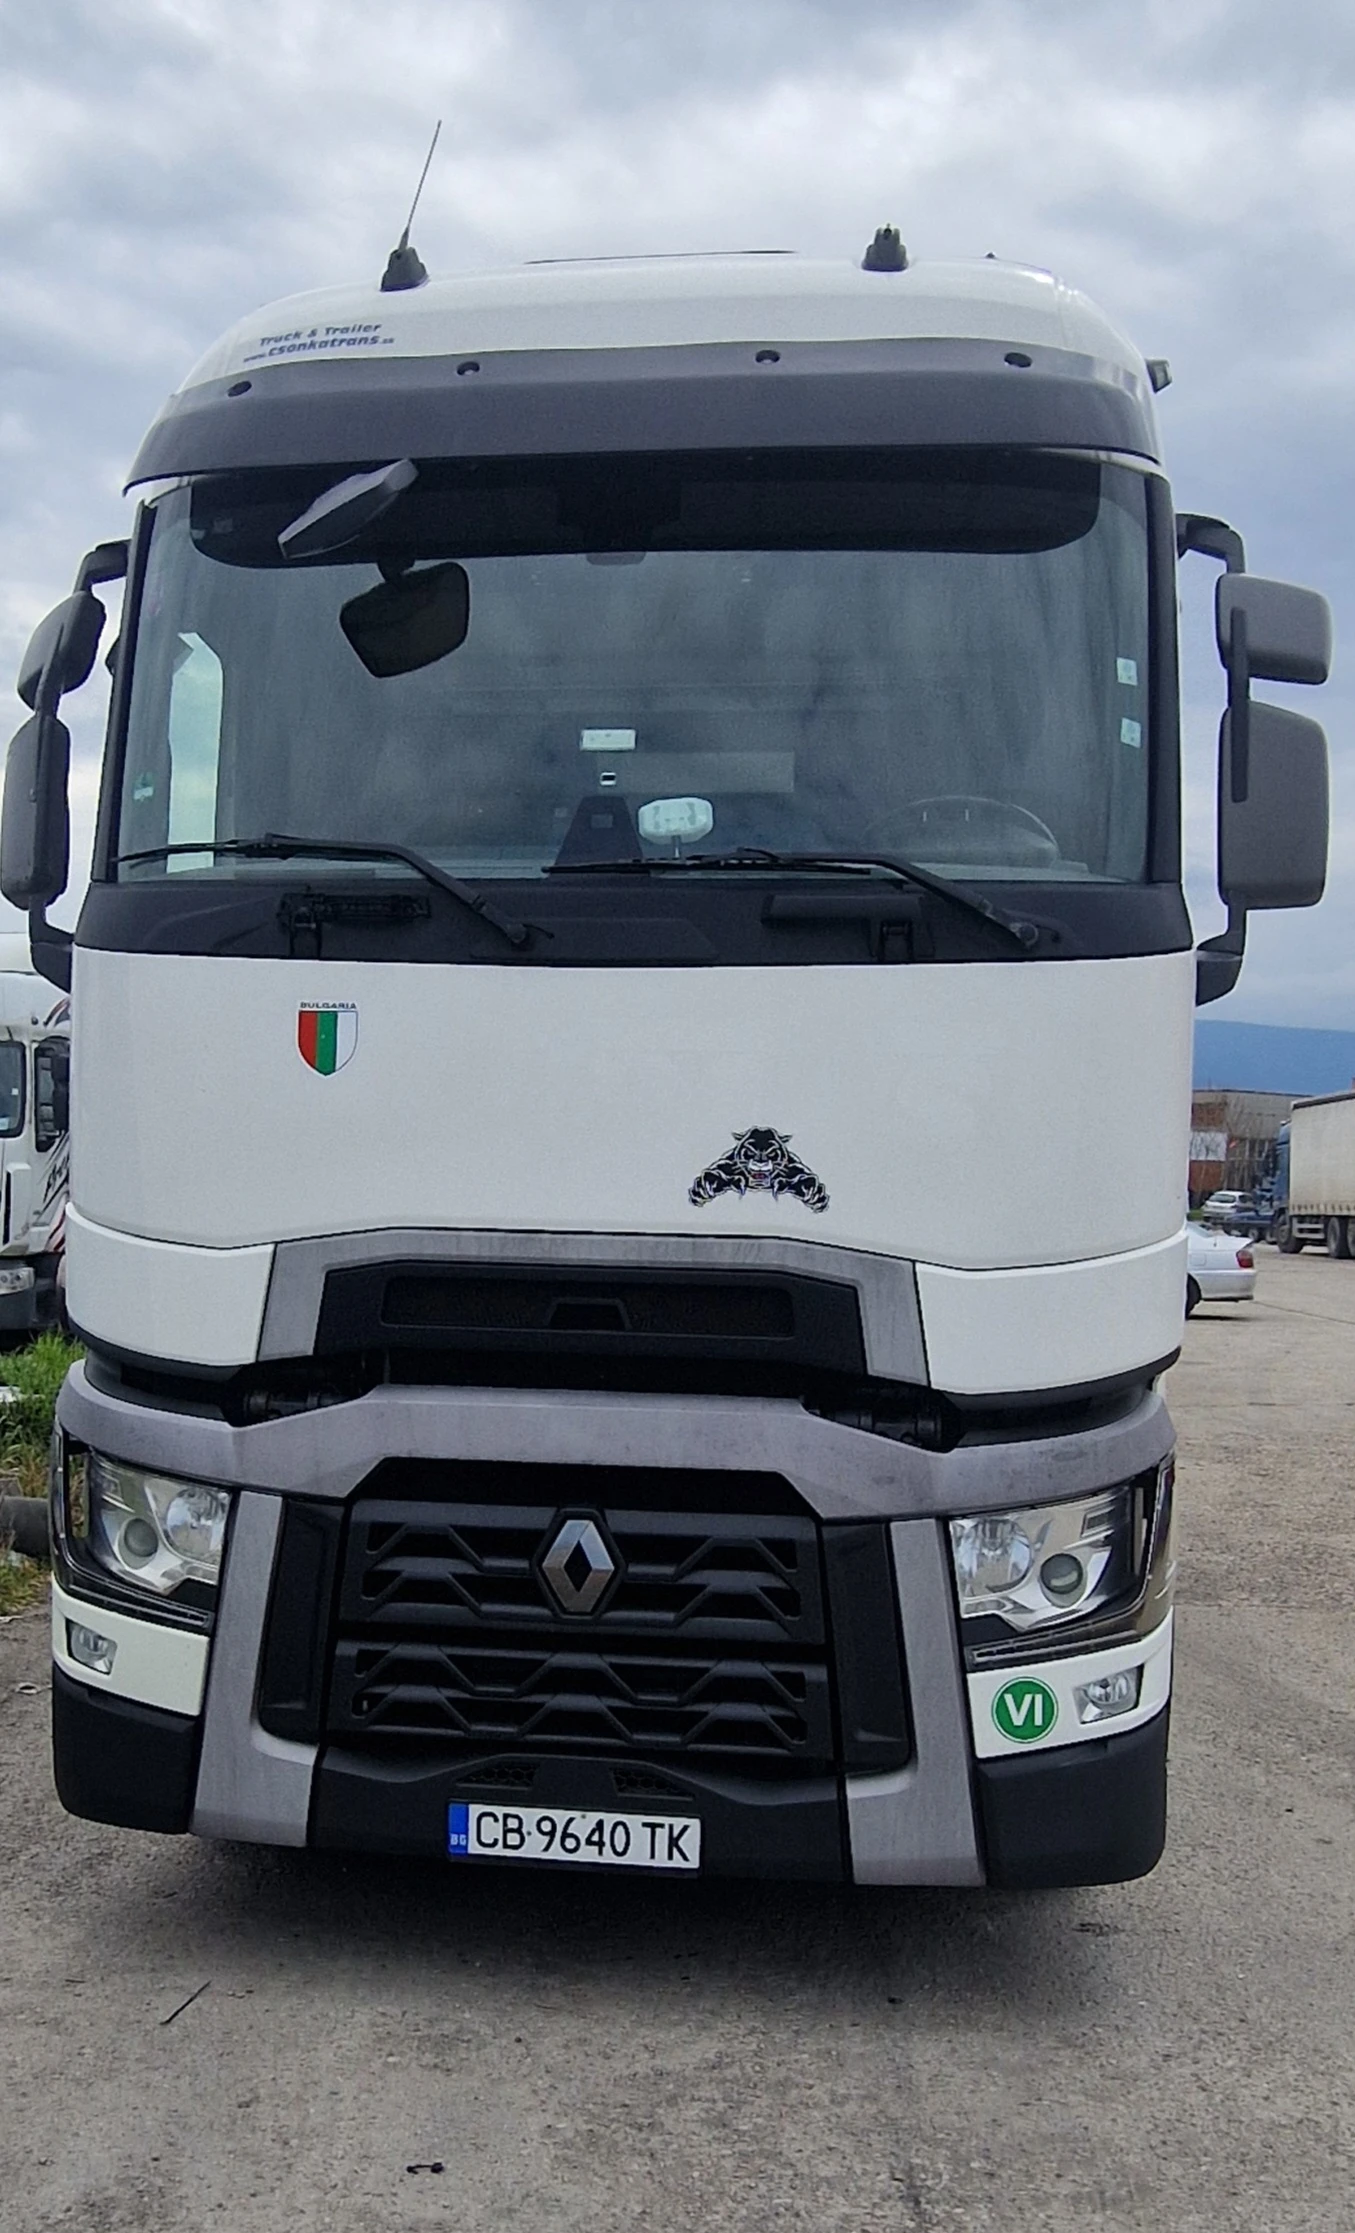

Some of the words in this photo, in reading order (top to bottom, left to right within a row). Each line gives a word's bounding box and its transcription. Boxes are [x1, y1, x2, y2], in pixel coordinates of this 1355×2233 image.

[260, 331, 304, 347] Truck
[307, 328, 318, 338] &
[325, 323, 382, 336] Trailer
[1003, 1693, 1043, 1726] VI
[450, 1833, 467, 1845] BG
[476, 1811, 526, 1851] CB
[535, 1815, 631, 1858] 9640
[641, 1821, 691, 1862] TK
